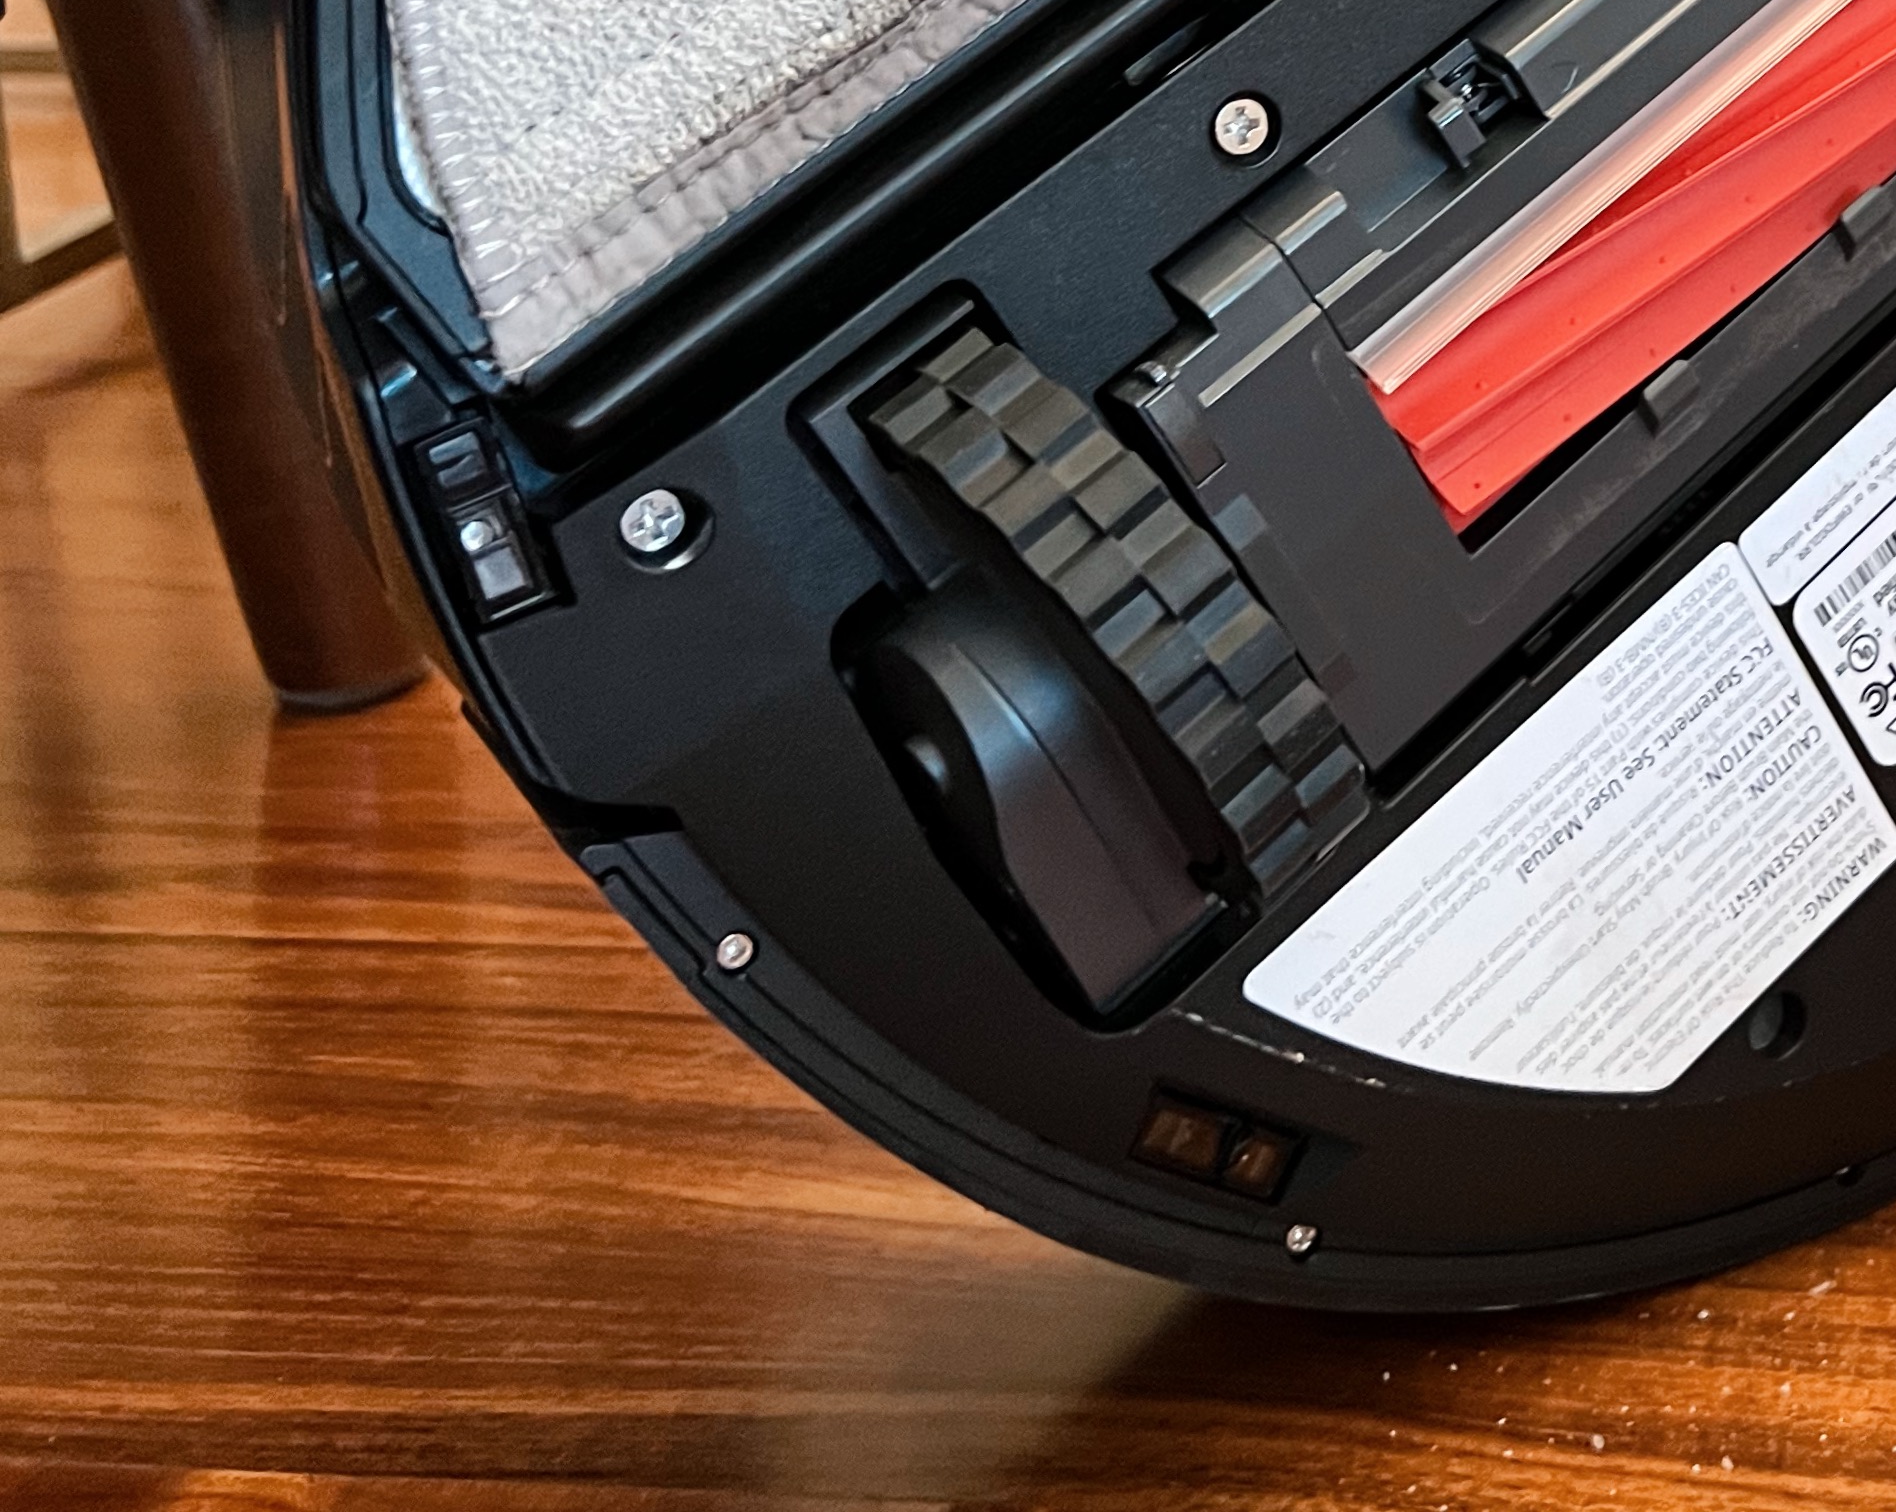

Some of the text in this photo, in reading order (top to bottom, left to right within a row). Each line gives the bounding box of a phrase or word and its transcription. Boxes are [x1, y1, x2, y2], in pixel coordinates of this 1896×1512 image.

[1739, 634, 1774, 675] FCC
[1652, 663, 1744, 757] Statement:
[1697, 685, 1804, 794] ATTENTION:
[1579, 775, 1625, 825] User
[1620, 745, 1657, 787] See
[1741, 720, 1823, 805] CAUTION:
[1514, 813, 1584, 885] Manual
[1720, 783, 1859, 925] AVERTISSEMENT:
[1796, 832, 1888, 928] WARNING:
